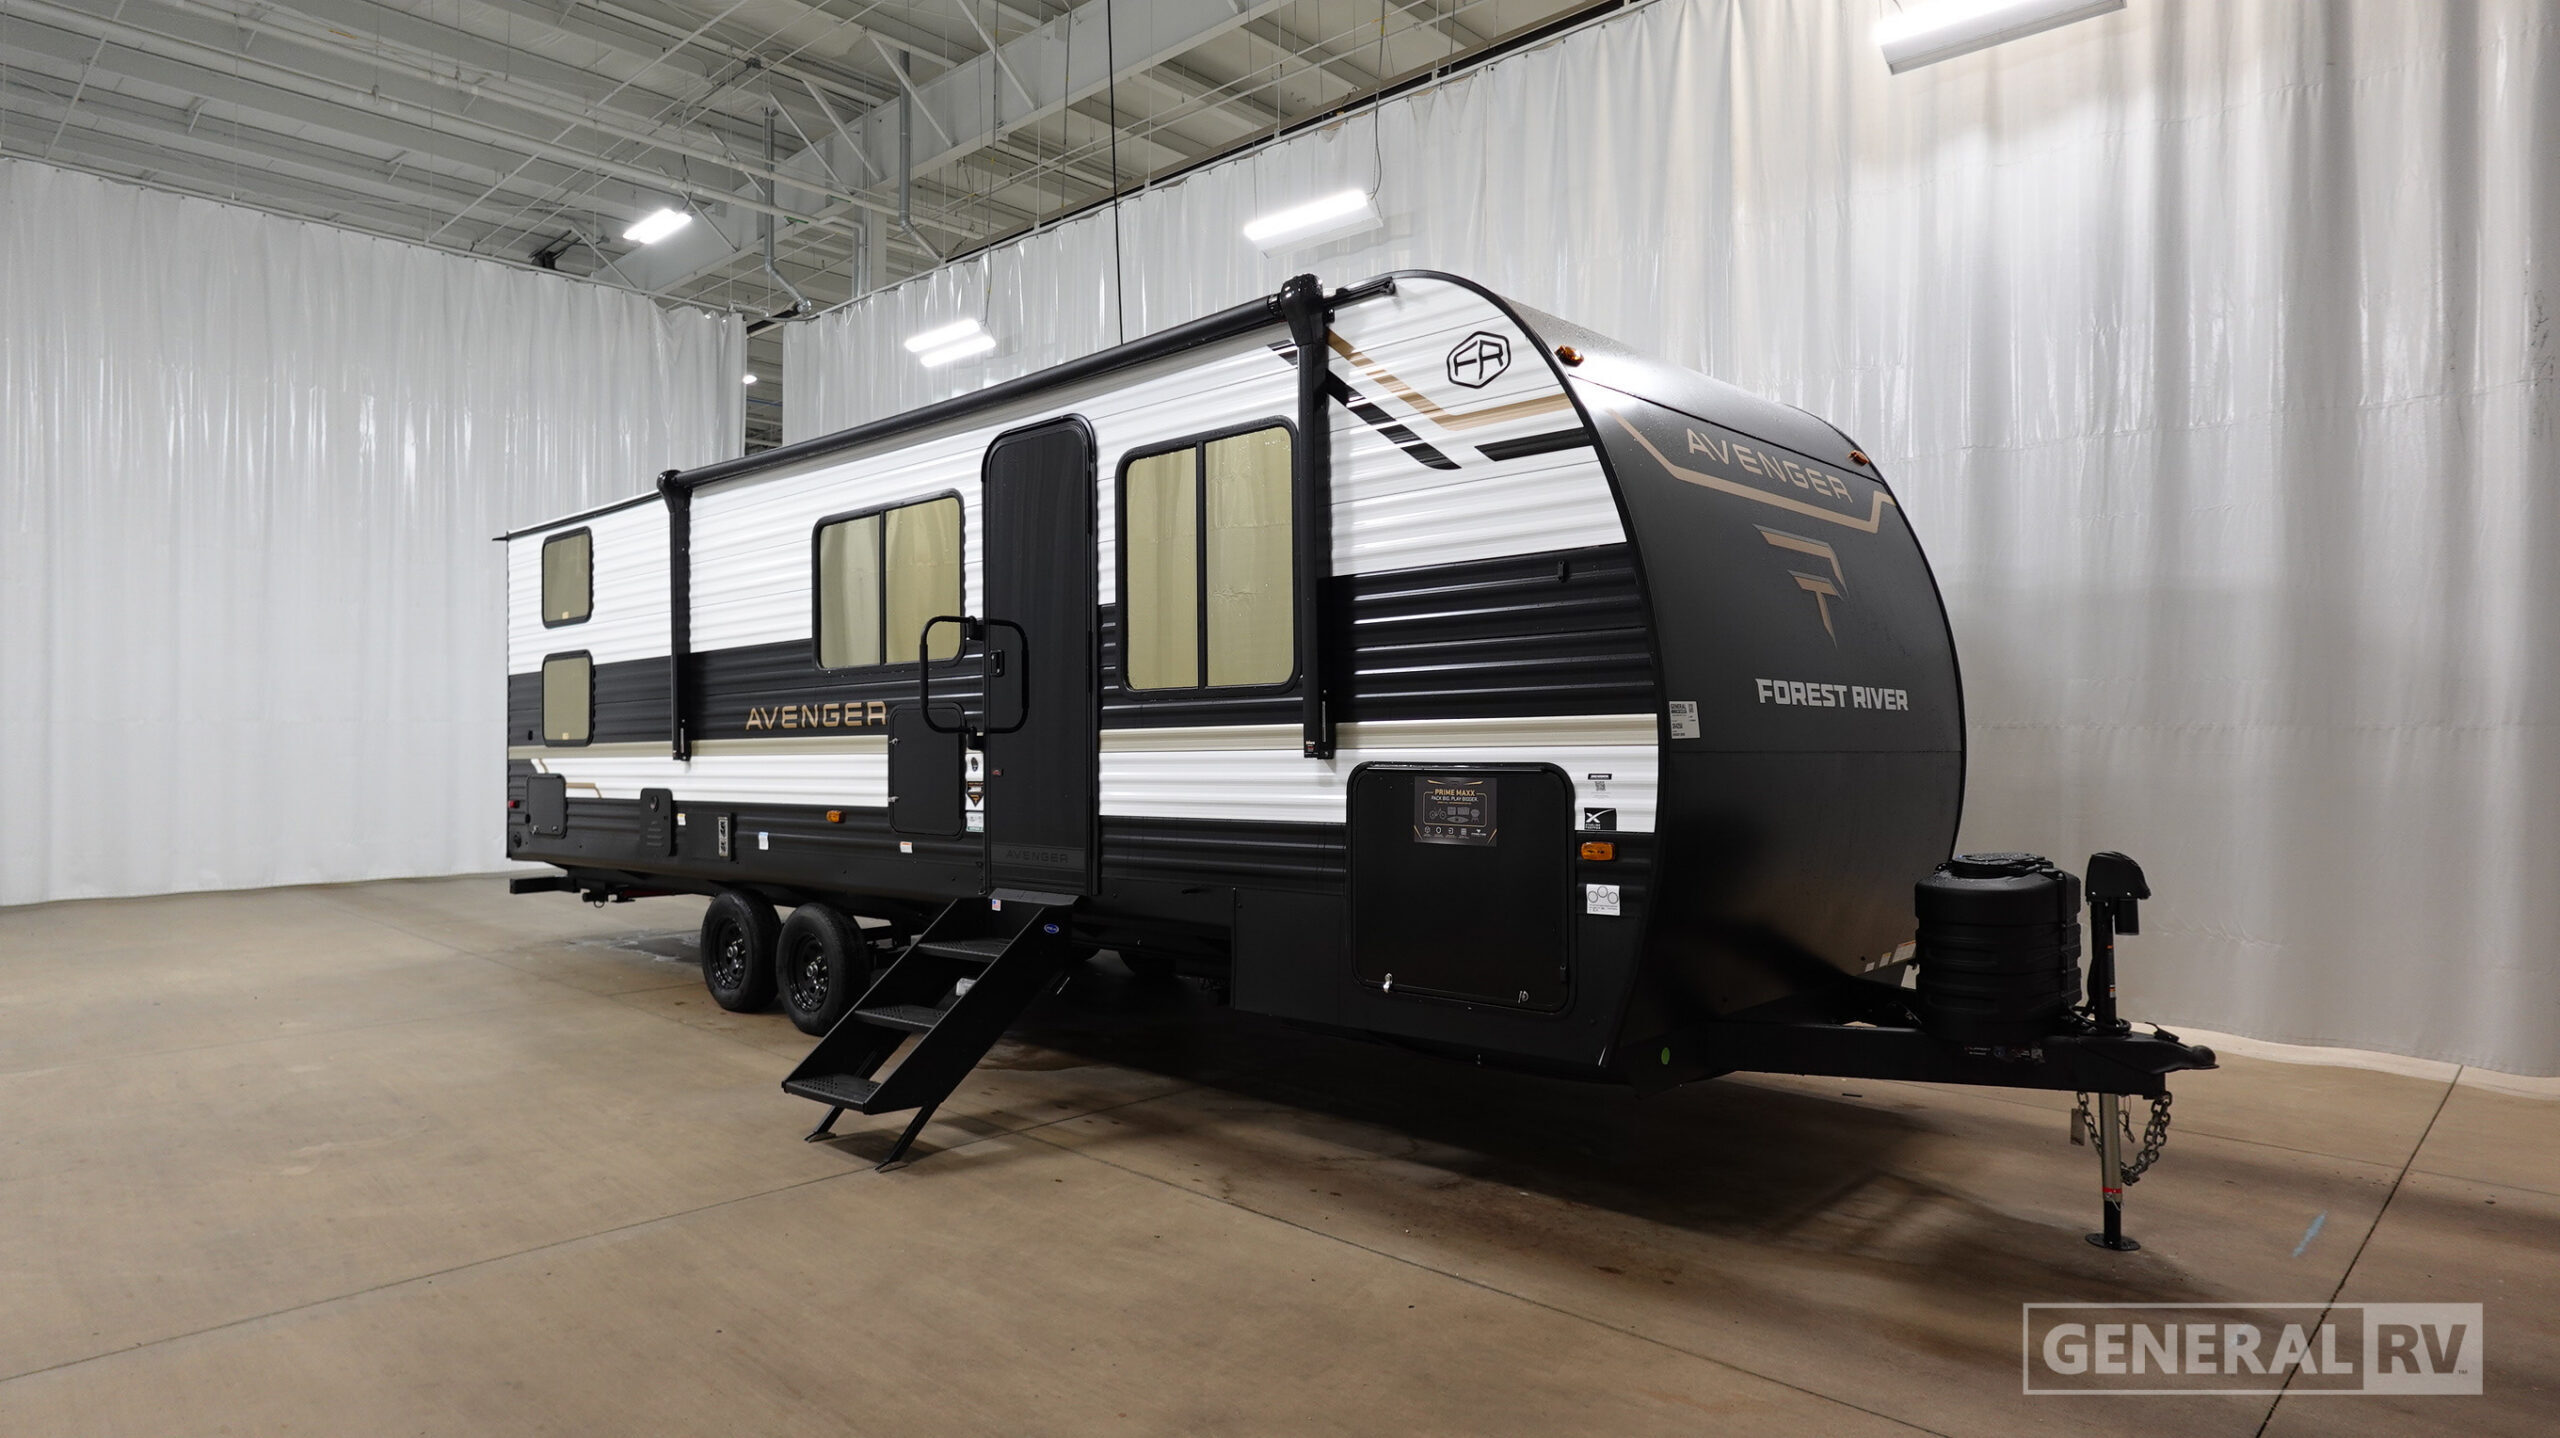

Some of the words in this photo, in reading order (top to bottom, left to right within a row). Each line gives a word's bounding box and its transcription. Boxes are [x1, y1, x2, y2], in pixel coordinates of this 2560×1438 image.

[1686, 427, 1853, 504] AVENGER
[1755, 678, 1848, 708] FOREST
[1851, 685, 1909, 711] RIVER
[745, 700, 887, 730] AVENGER
[1434, 788, 1455, 796] PRIME
[1456, 788, 1475, 796] MAXX
[1006, 849, 1069, 863] AVENGER
